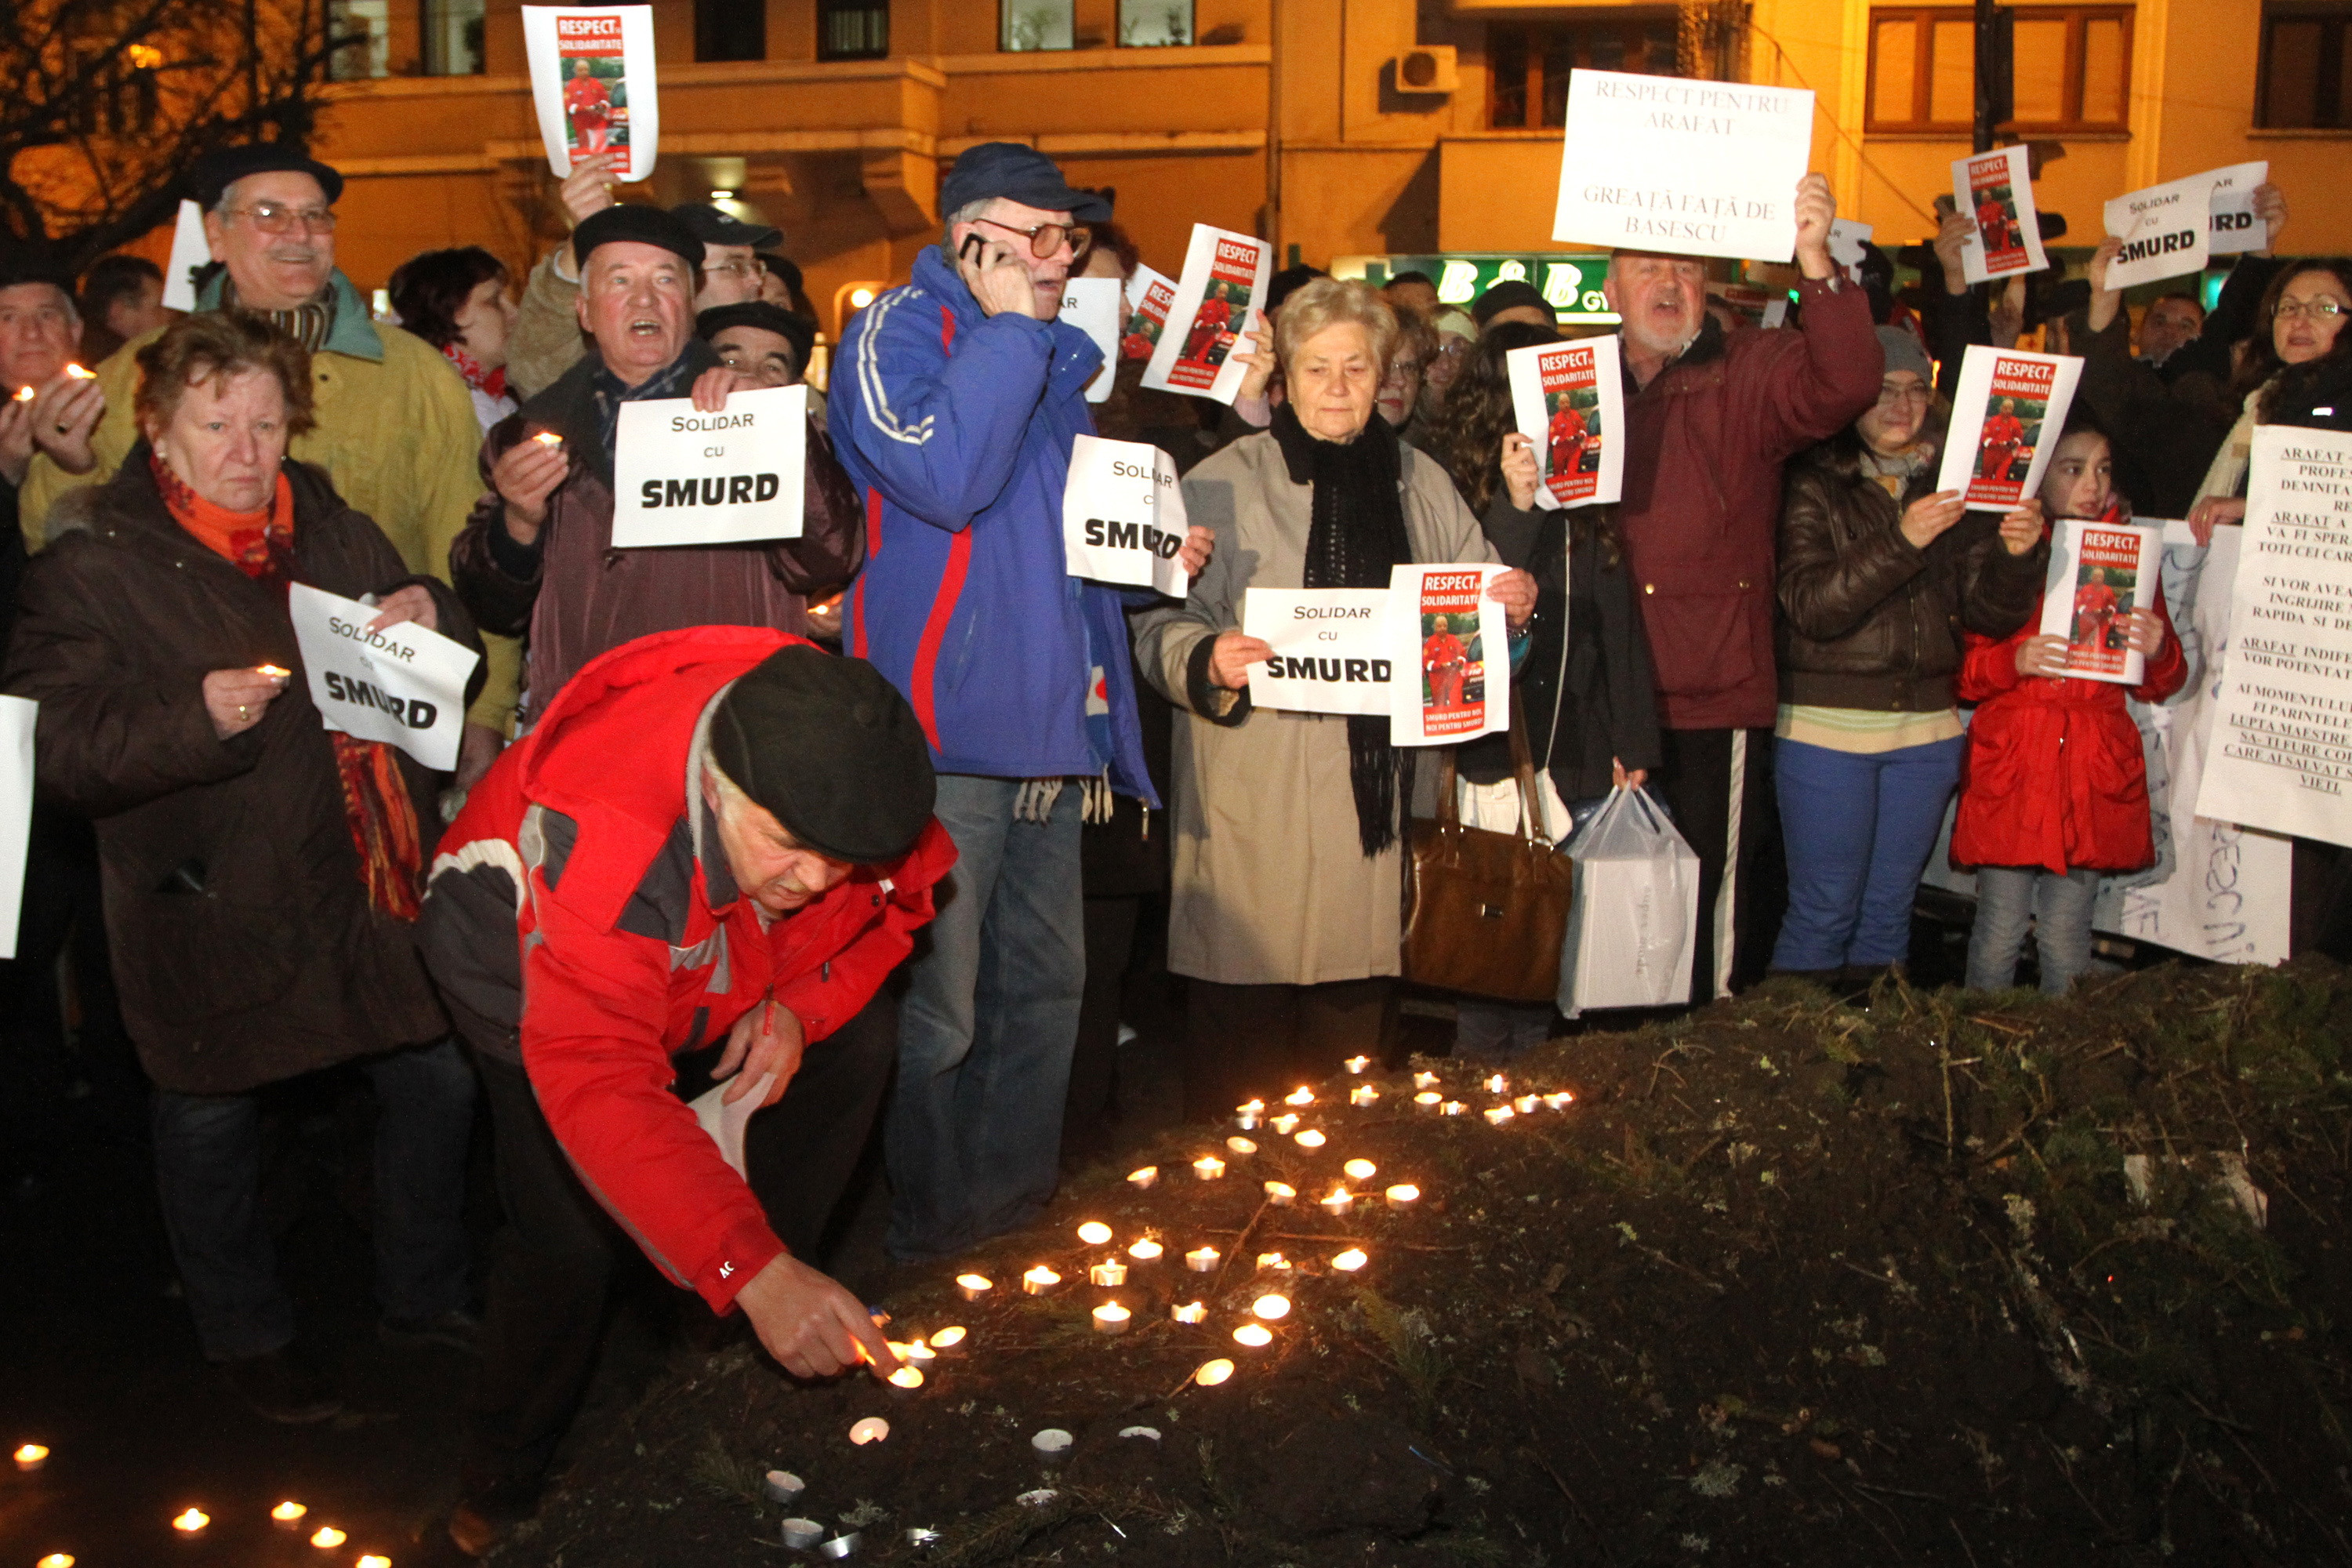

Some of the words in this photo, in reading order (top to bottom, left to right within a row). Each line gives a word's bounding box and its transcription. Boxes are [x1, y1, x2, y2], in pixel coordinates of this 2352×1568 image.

[559, 19, 616, 35] RESPECT
[1595, 80, 1694, 104] RESPECT
[1700, 90, 1790, 114] PENTRU
[1644, 111, 1735, 136] ARAFAT
[1746, 201, 1776, 221] DE
[1625, 216, 1727, 243] BASESCU
[1218, 241, 1257, 265] RESPECT
[2116, 230, 2195, 264] SMURD
[1541, 351, 1588, 372] RESPECT
[1998, 360, 2049, 380] RESPECT
[1542, 369, 1595, 387] SOLIDARITATE
[703, 446, 724, 458] CU
[2282, 447, 2343, 462] ARAFAT
[641, 472, 779, 509] SMURD
[2272, 511, 2329, 526] ARAFAT
[2085, 532, 2134, 550] RESPECT
[2267, 526, 2286, 539] VA
[2294, 529, 2307, 540] FI
[2314, 532, 2352, 546] SPER
[2295, 544, 2319, 558] CEI
[1425, 575, 1475, 591] RESPECT
[2263, 575, 2275, 586] SI
[2281, 578, 2310, 592] VOR
[1421, 593, 1479, 607] SOLIDARITATE
[2252, 606, 2305, 624] RAPIDA
[2313, 615, 2326, 627] SI
[1318, 631, 1338, 641] CU
[2241, 637, 2296, 655] ARAFAT
[2244, 652, 2273, 666] VOR
[1265, 655, 1392, 683] SMURD
[2237, 683, 2251, 695] AI
[324, 670, 437, 730] SMURD
[1448, 710, 1472, 720] PENTRU
[2253, 701, 2267, 713] FI
[2270, 704, 2350, 728] PARINTELE
[1438, 721, 1462, 731] PENTRU
[2230, 713, 2274, 732] LUPTA
[2280, 722, 2347, 746] MAESTRE
[2223, 744, 2262, 760] CARE
